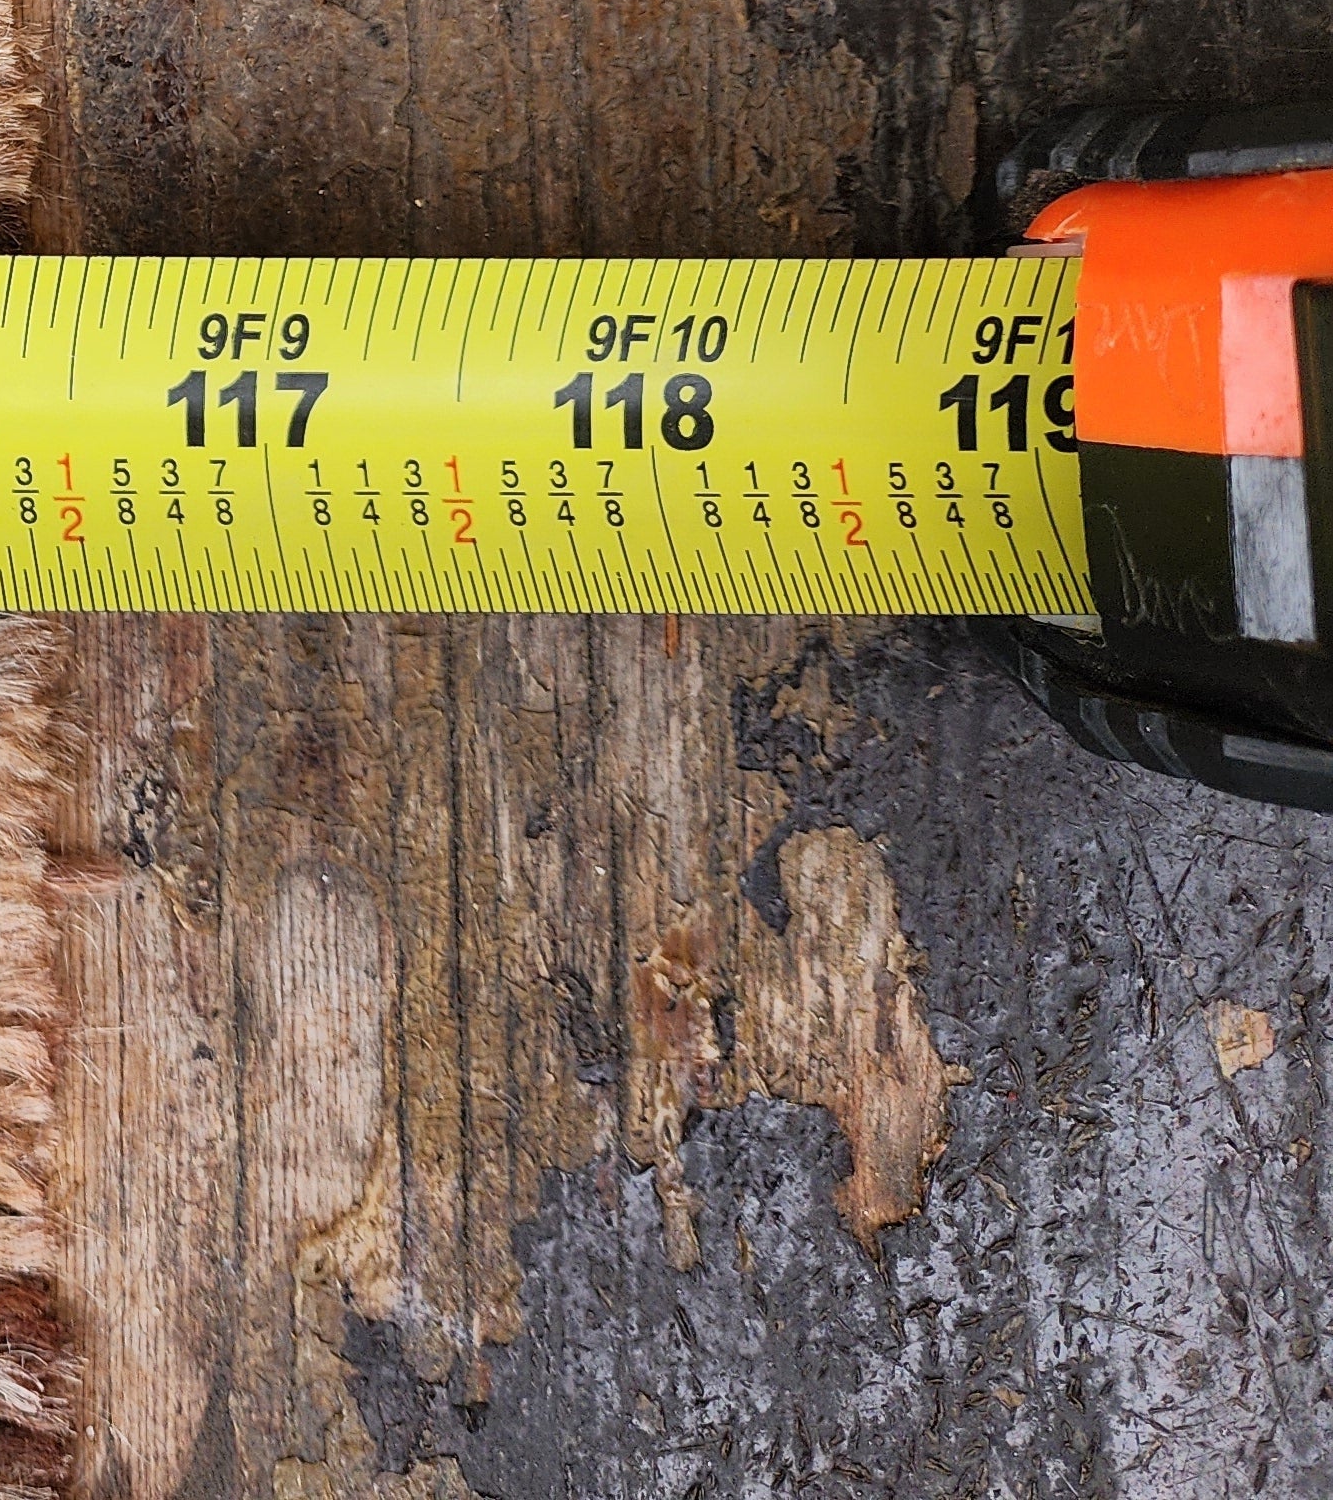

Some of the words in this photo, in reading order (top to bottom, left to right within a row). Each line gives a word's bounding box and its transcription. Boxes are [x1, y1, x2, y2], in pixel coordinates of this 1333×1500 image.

[198, 313, 267, 360] 9F
[279, 314, 309, 360] 9
[586, 315, 657, 362] 9F
[671, 315, 728, 362] 10
[971, 316, 1043, 364] 9F
[167, 370, 329, 448] 117
[554, 372, 714, 451] 118
[939, 374, 1078, 453] 119
